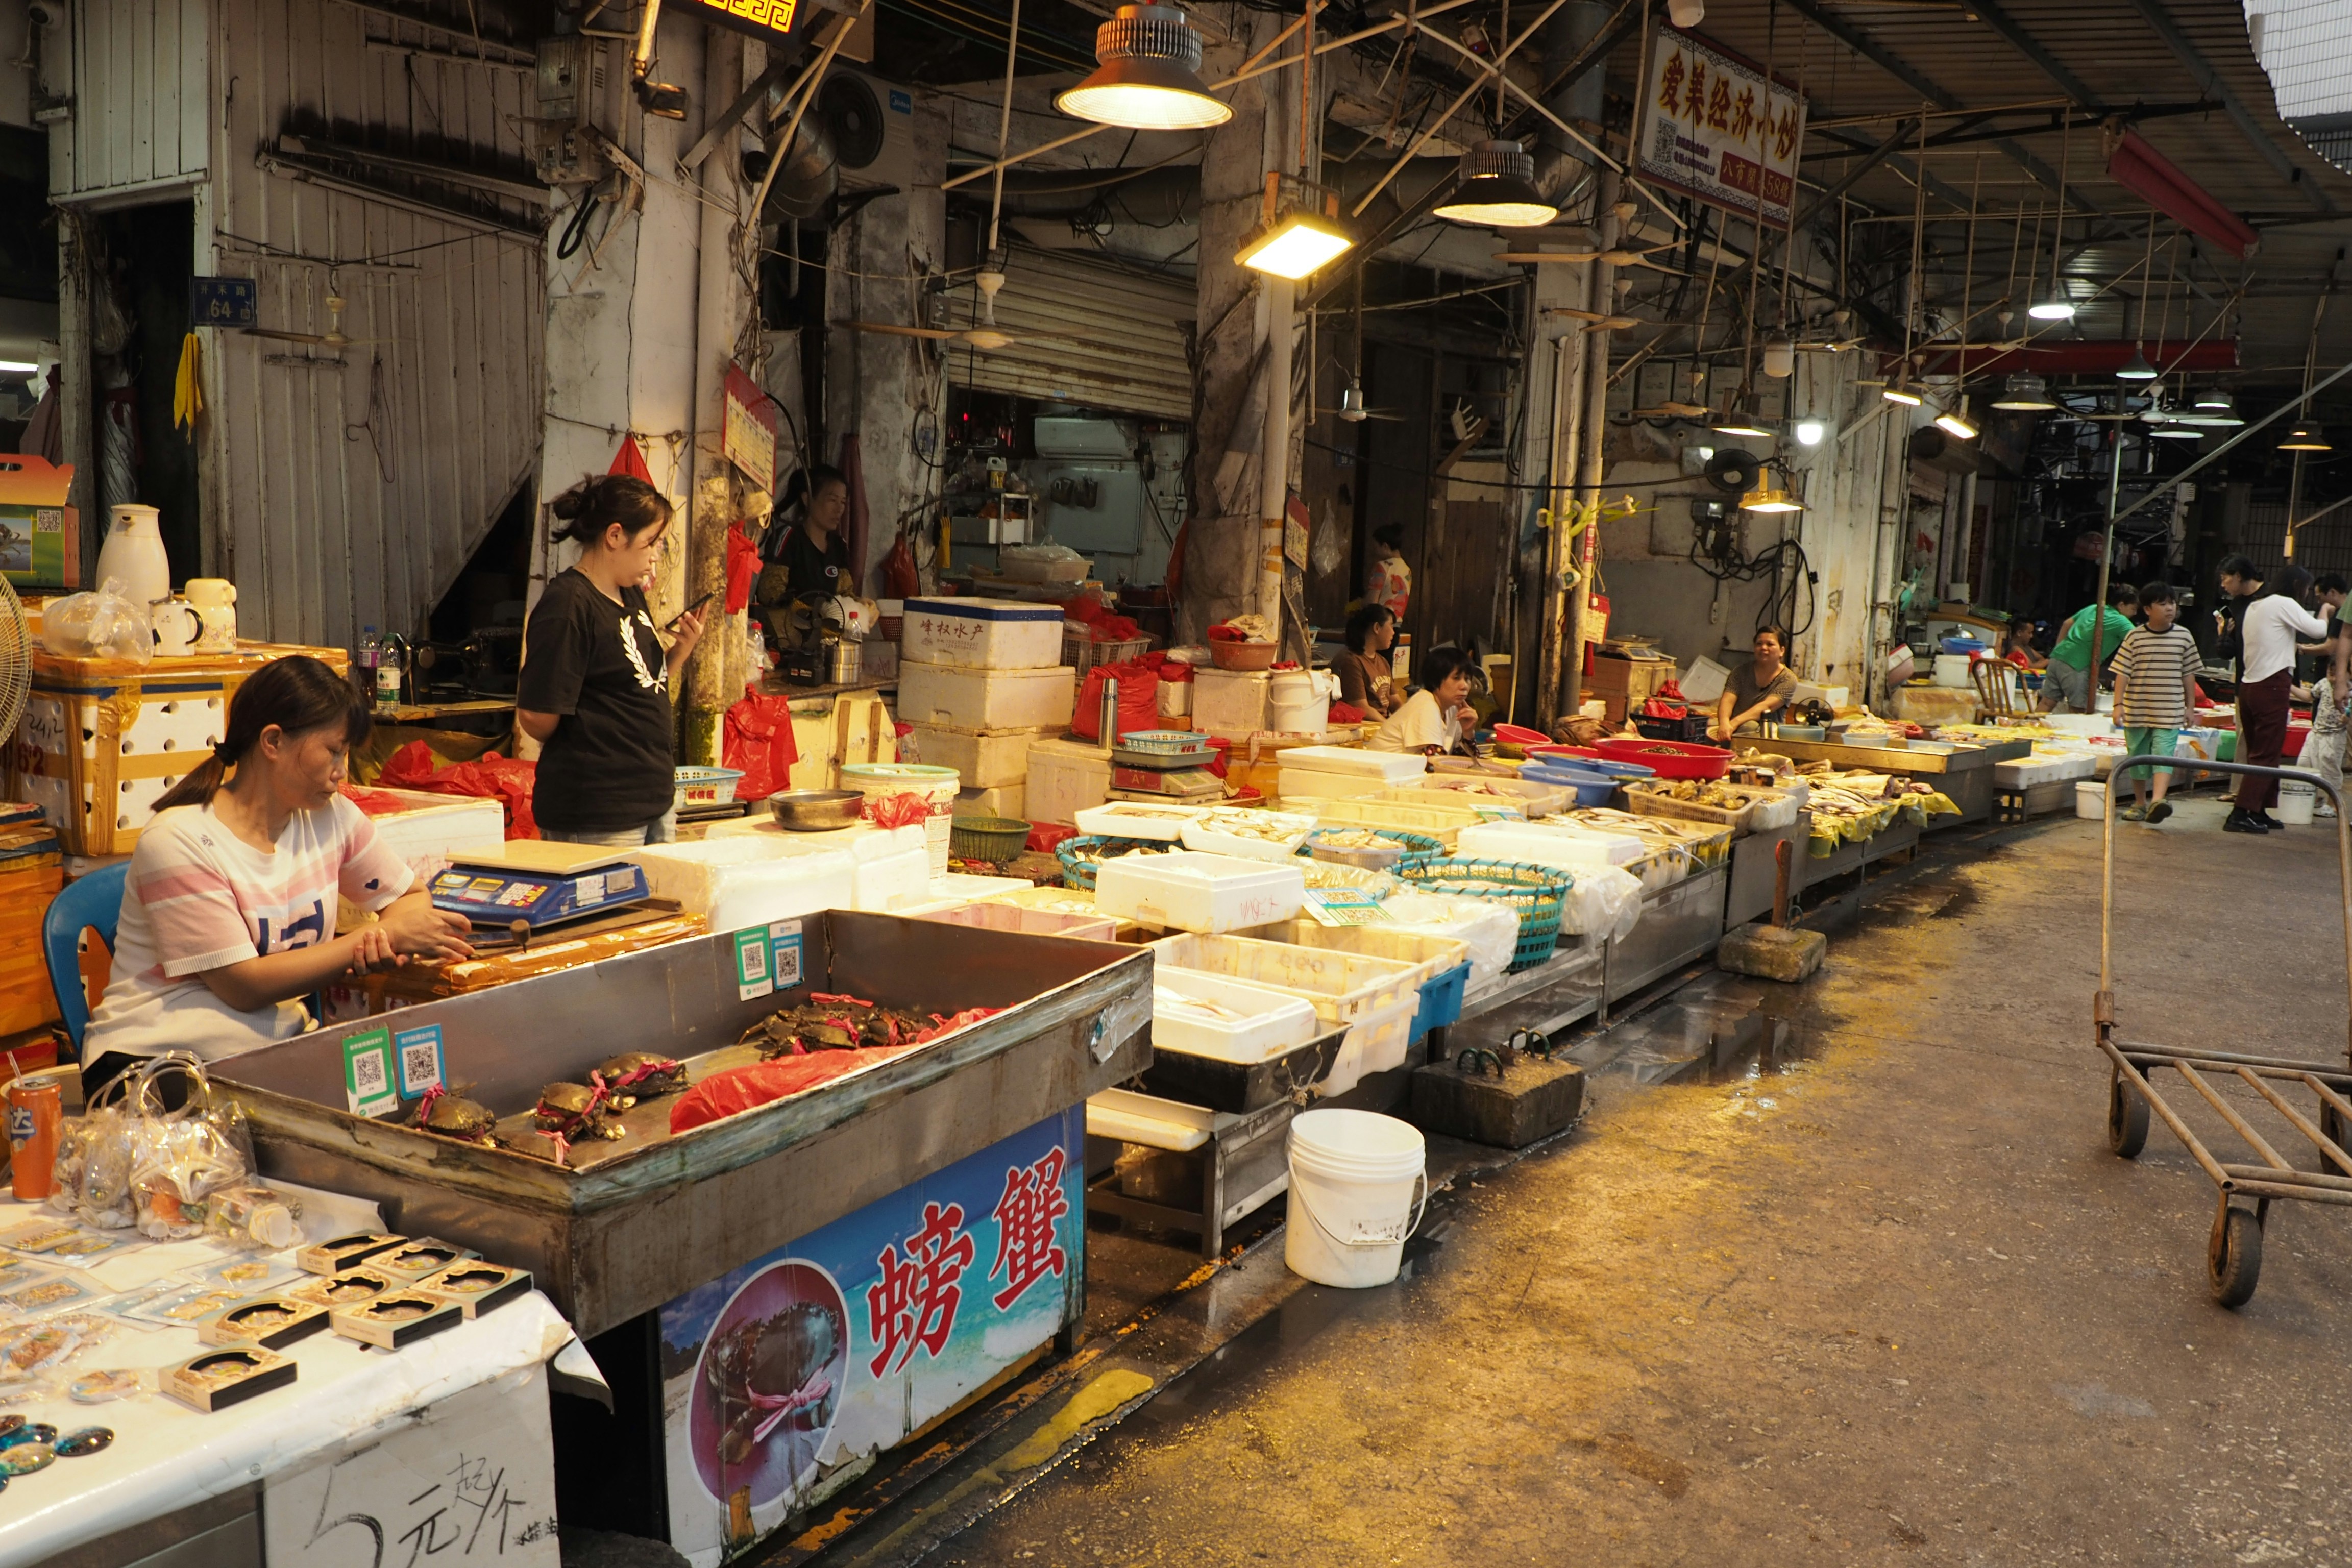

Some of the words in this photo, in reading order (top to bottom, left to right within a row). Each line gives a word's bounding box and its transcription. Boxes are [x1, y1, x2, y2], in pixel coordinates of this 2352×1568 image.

[210, 298, 232, 318] 64
[920, 618, 984, 640] 峰权水产
[866, 1146, 1069, 1379] 螃蟹
